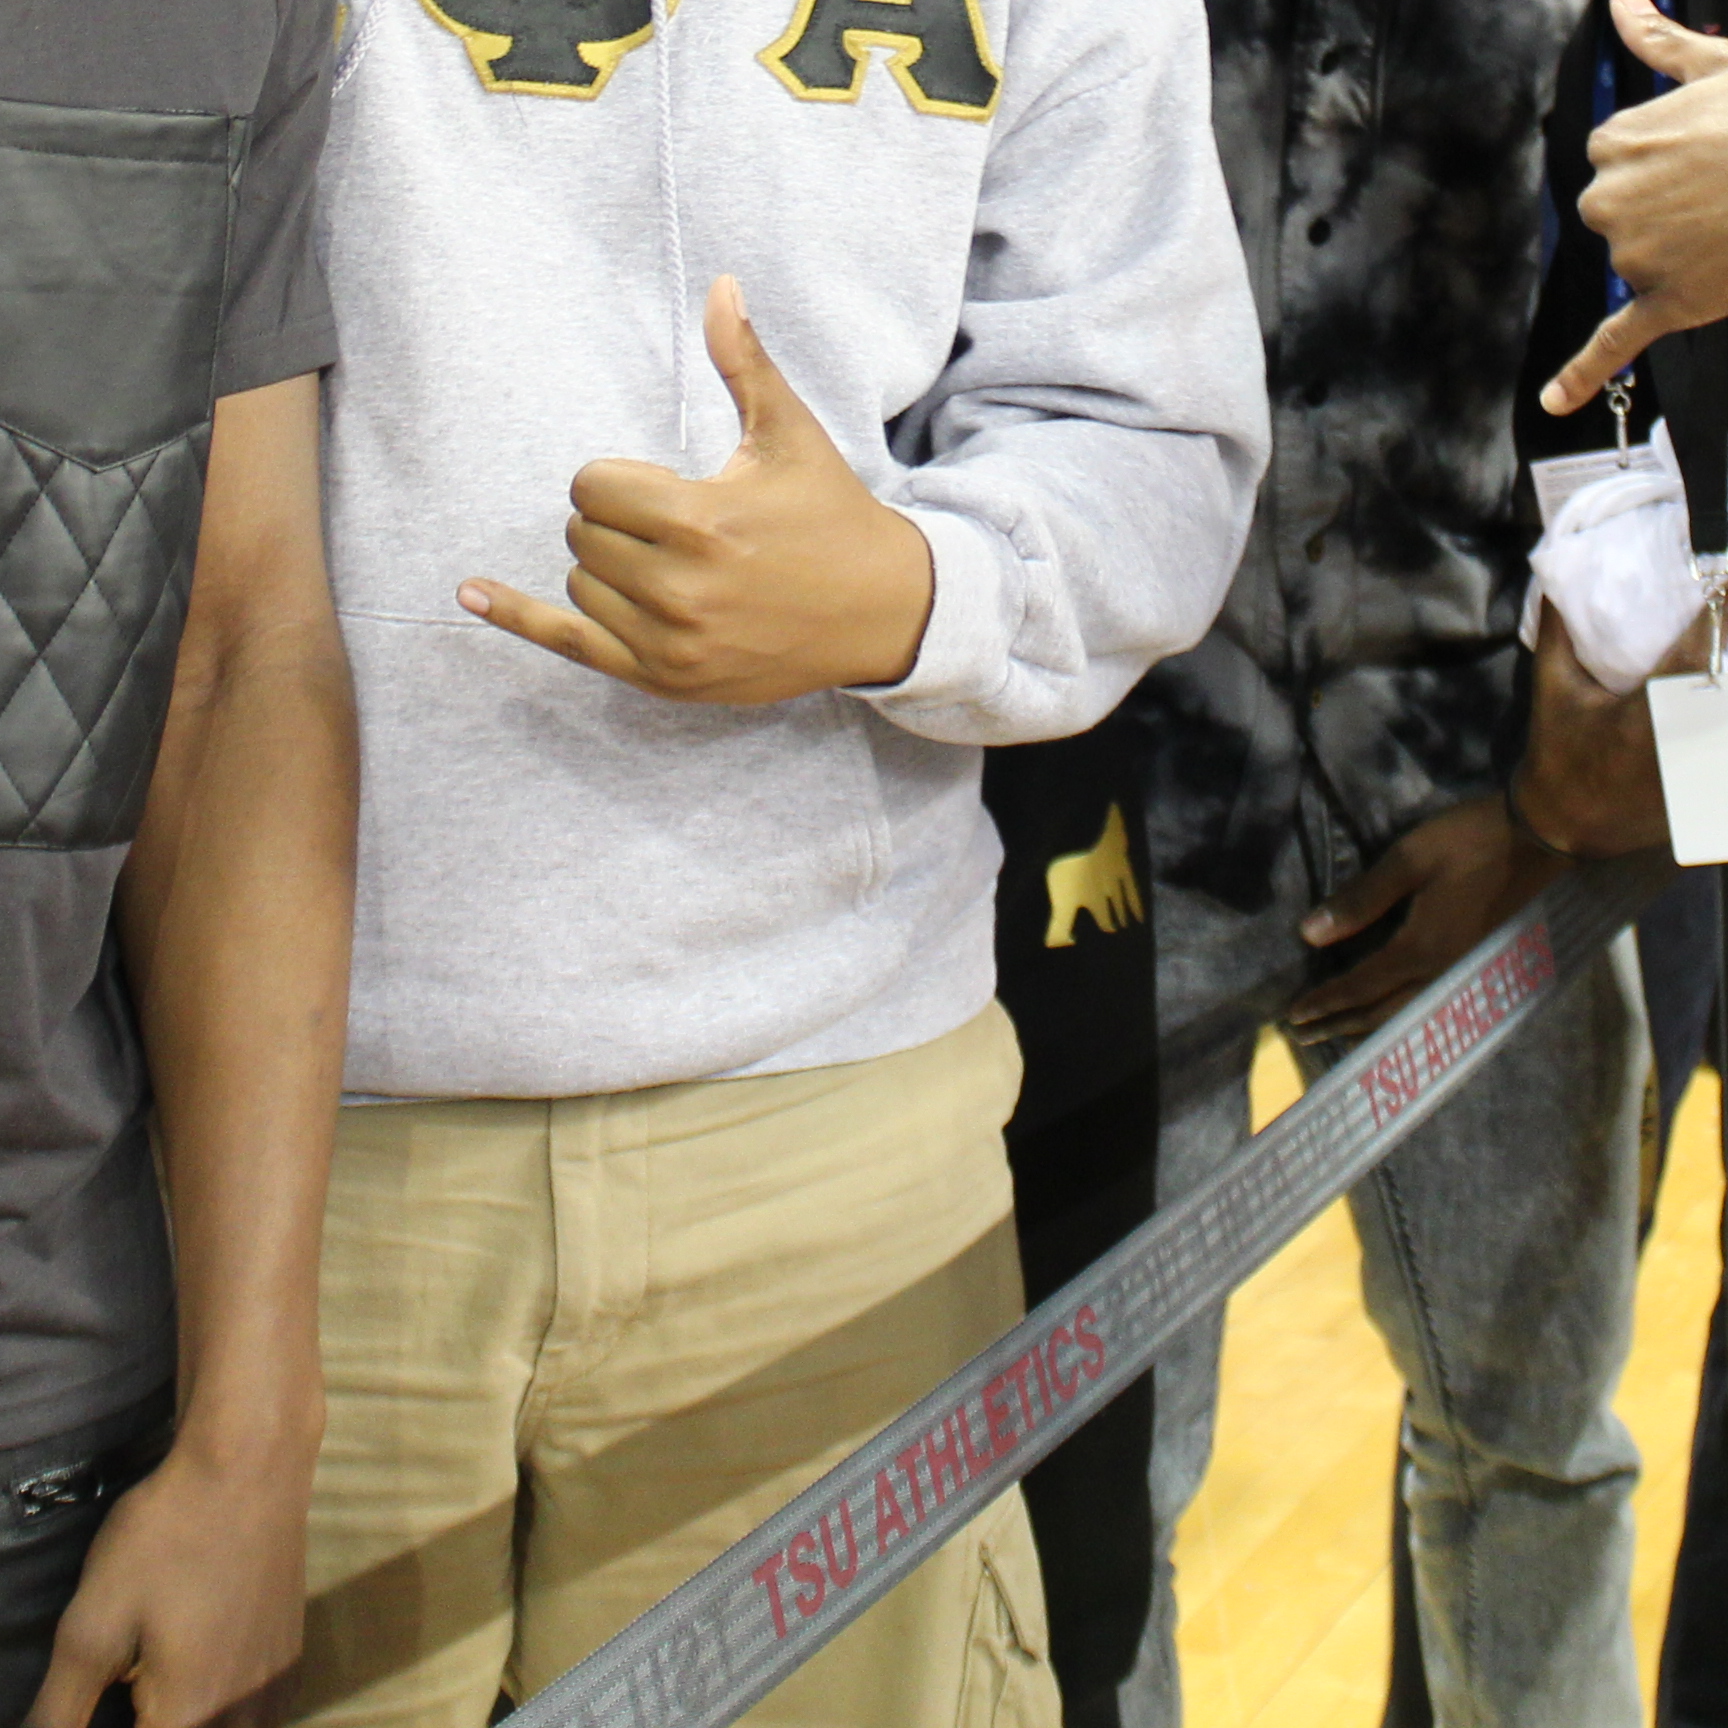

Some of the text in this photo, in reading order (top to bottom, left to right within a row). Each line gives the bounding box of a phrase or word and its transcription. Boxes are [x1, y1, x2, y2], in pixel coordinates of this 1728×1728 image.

[1358, 924, 1555, 1130] TSU ATHLETICS
[752, 1305, 1106, 1640] TSU ATHLETICS
